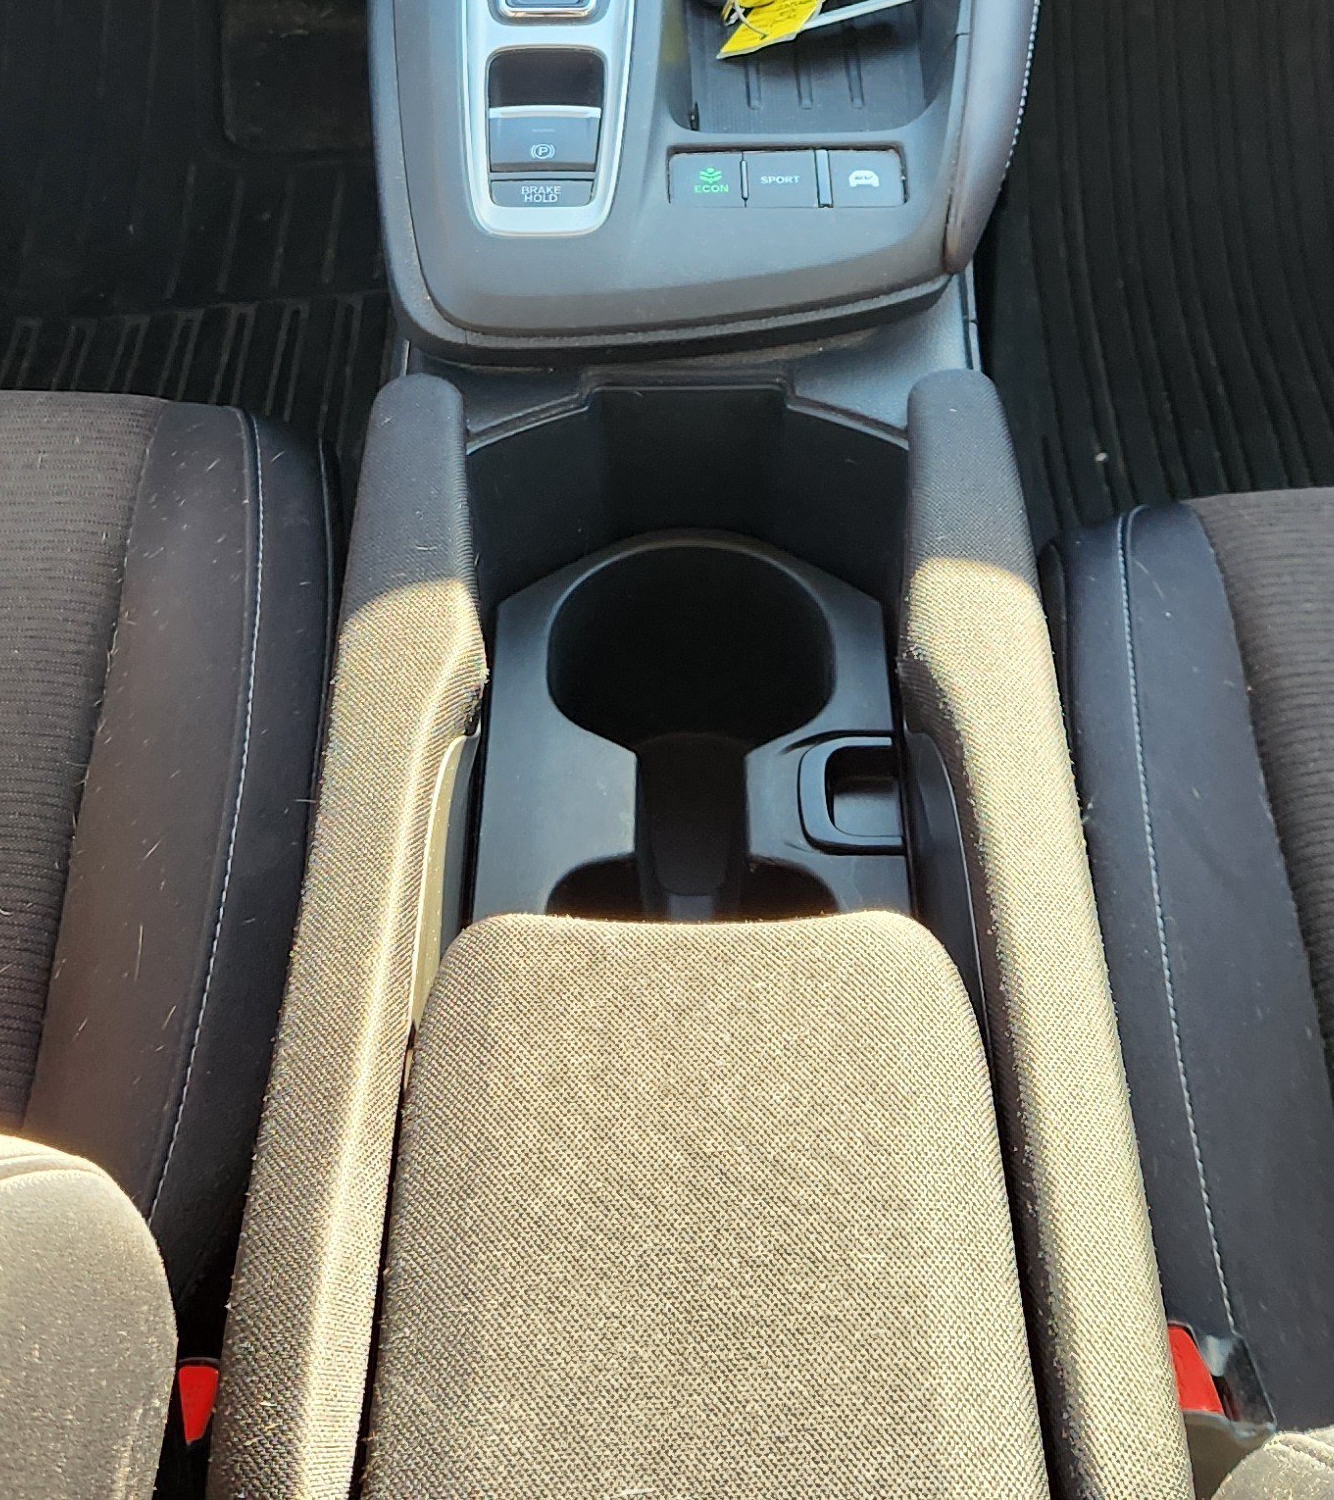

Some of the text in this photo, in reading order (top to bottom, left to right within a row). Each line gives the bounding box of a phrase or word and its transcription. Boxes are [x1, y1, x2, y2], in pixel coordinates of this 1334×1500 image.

[761, 175, 800, 184] SPORT
[521, 186, 562, 195] BRAKE
[694, 184, 729, 193] ECON
[524, 193, 558, 203] HOLD
